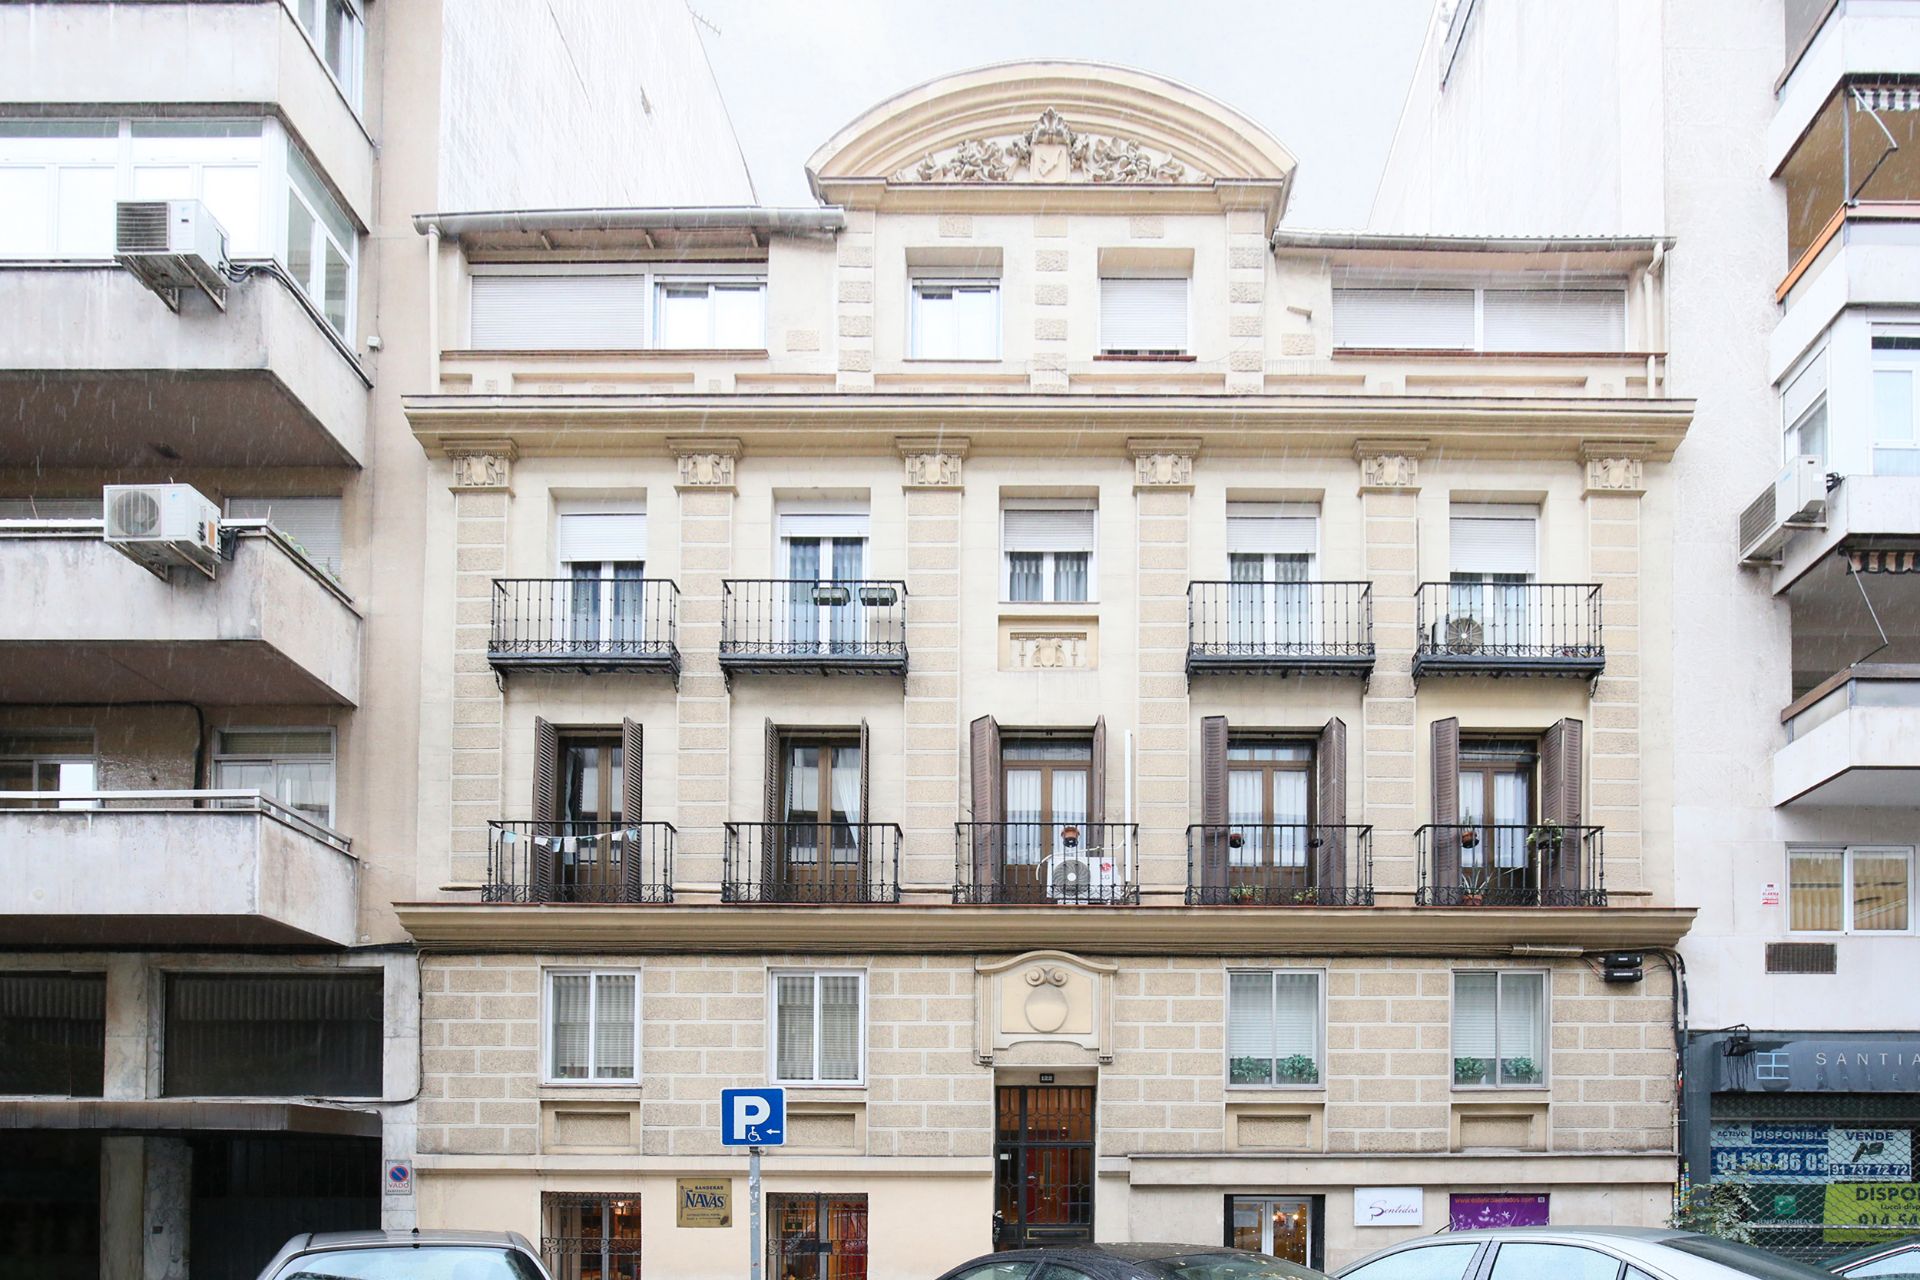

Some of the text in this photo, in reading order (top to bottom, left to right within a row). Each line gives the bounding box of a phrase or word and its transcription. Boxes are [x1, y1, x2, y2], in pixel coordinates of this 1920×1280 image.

[733, 1096, 771, 1140] P
[1754, 1130, 1829, 1140] DISPONIBLE
[1846, 1132, 1894, 1140] VENDE
[1716, 1151, 1737, 1170] 91
[1806, 1153, 1828, 1171] 03
[1832, 1165, 1908, 1175] 91 737 72 72
